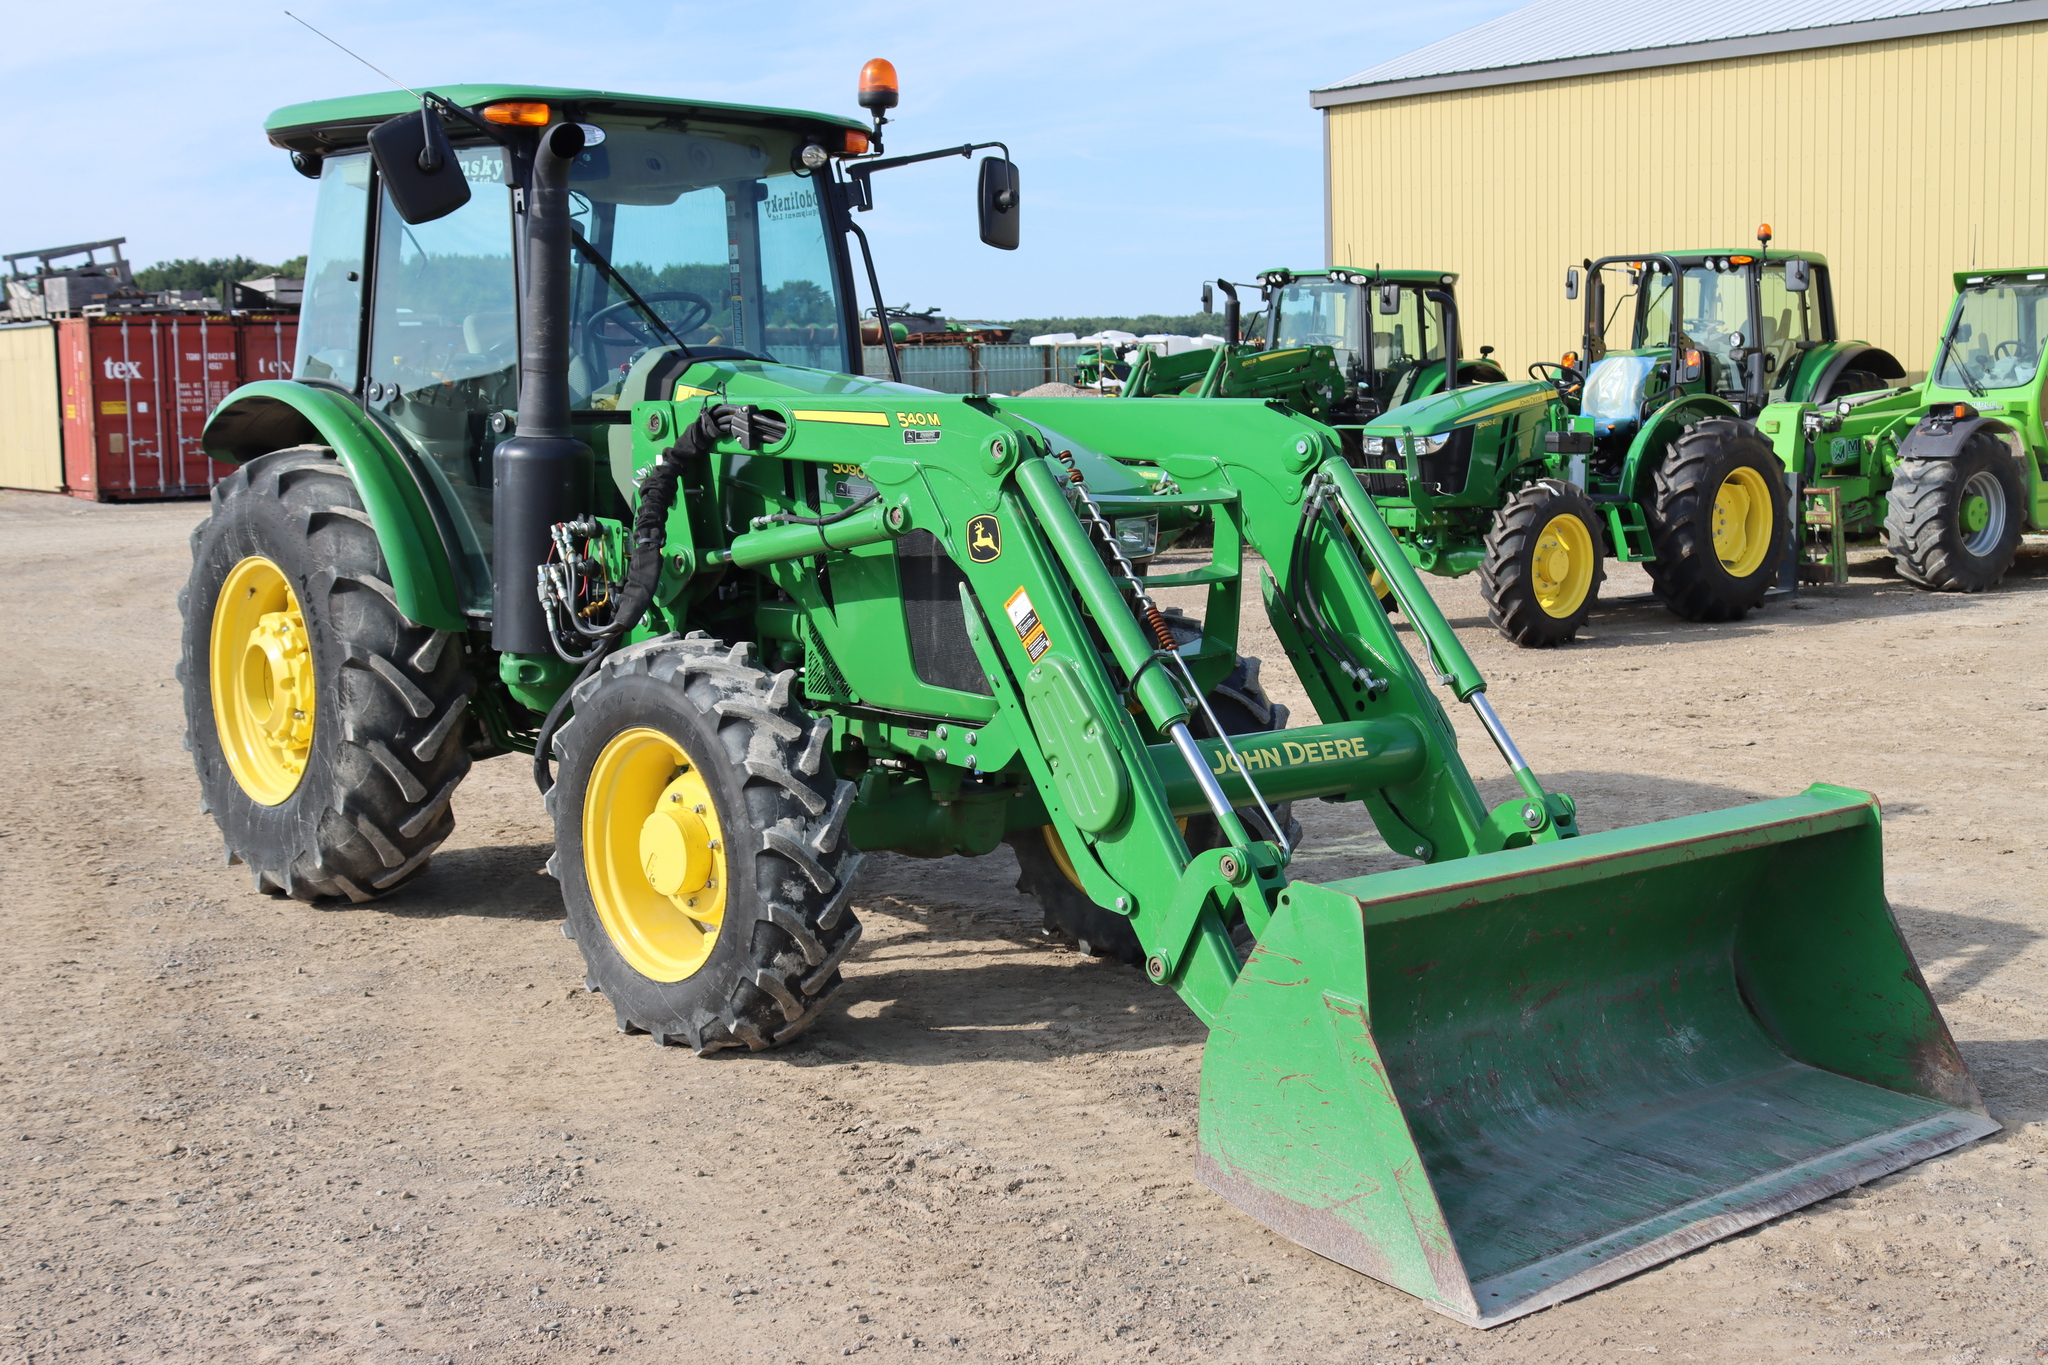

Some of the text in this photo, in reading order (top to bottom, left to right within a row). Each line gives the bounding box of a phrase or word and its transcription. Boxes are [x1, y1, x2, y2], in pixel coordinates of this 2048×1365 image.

[103, 355, 145, 380] tex
[258, 357, 293, 374] tex
[1213, 737, 1369, 775] JOHN DEERE
